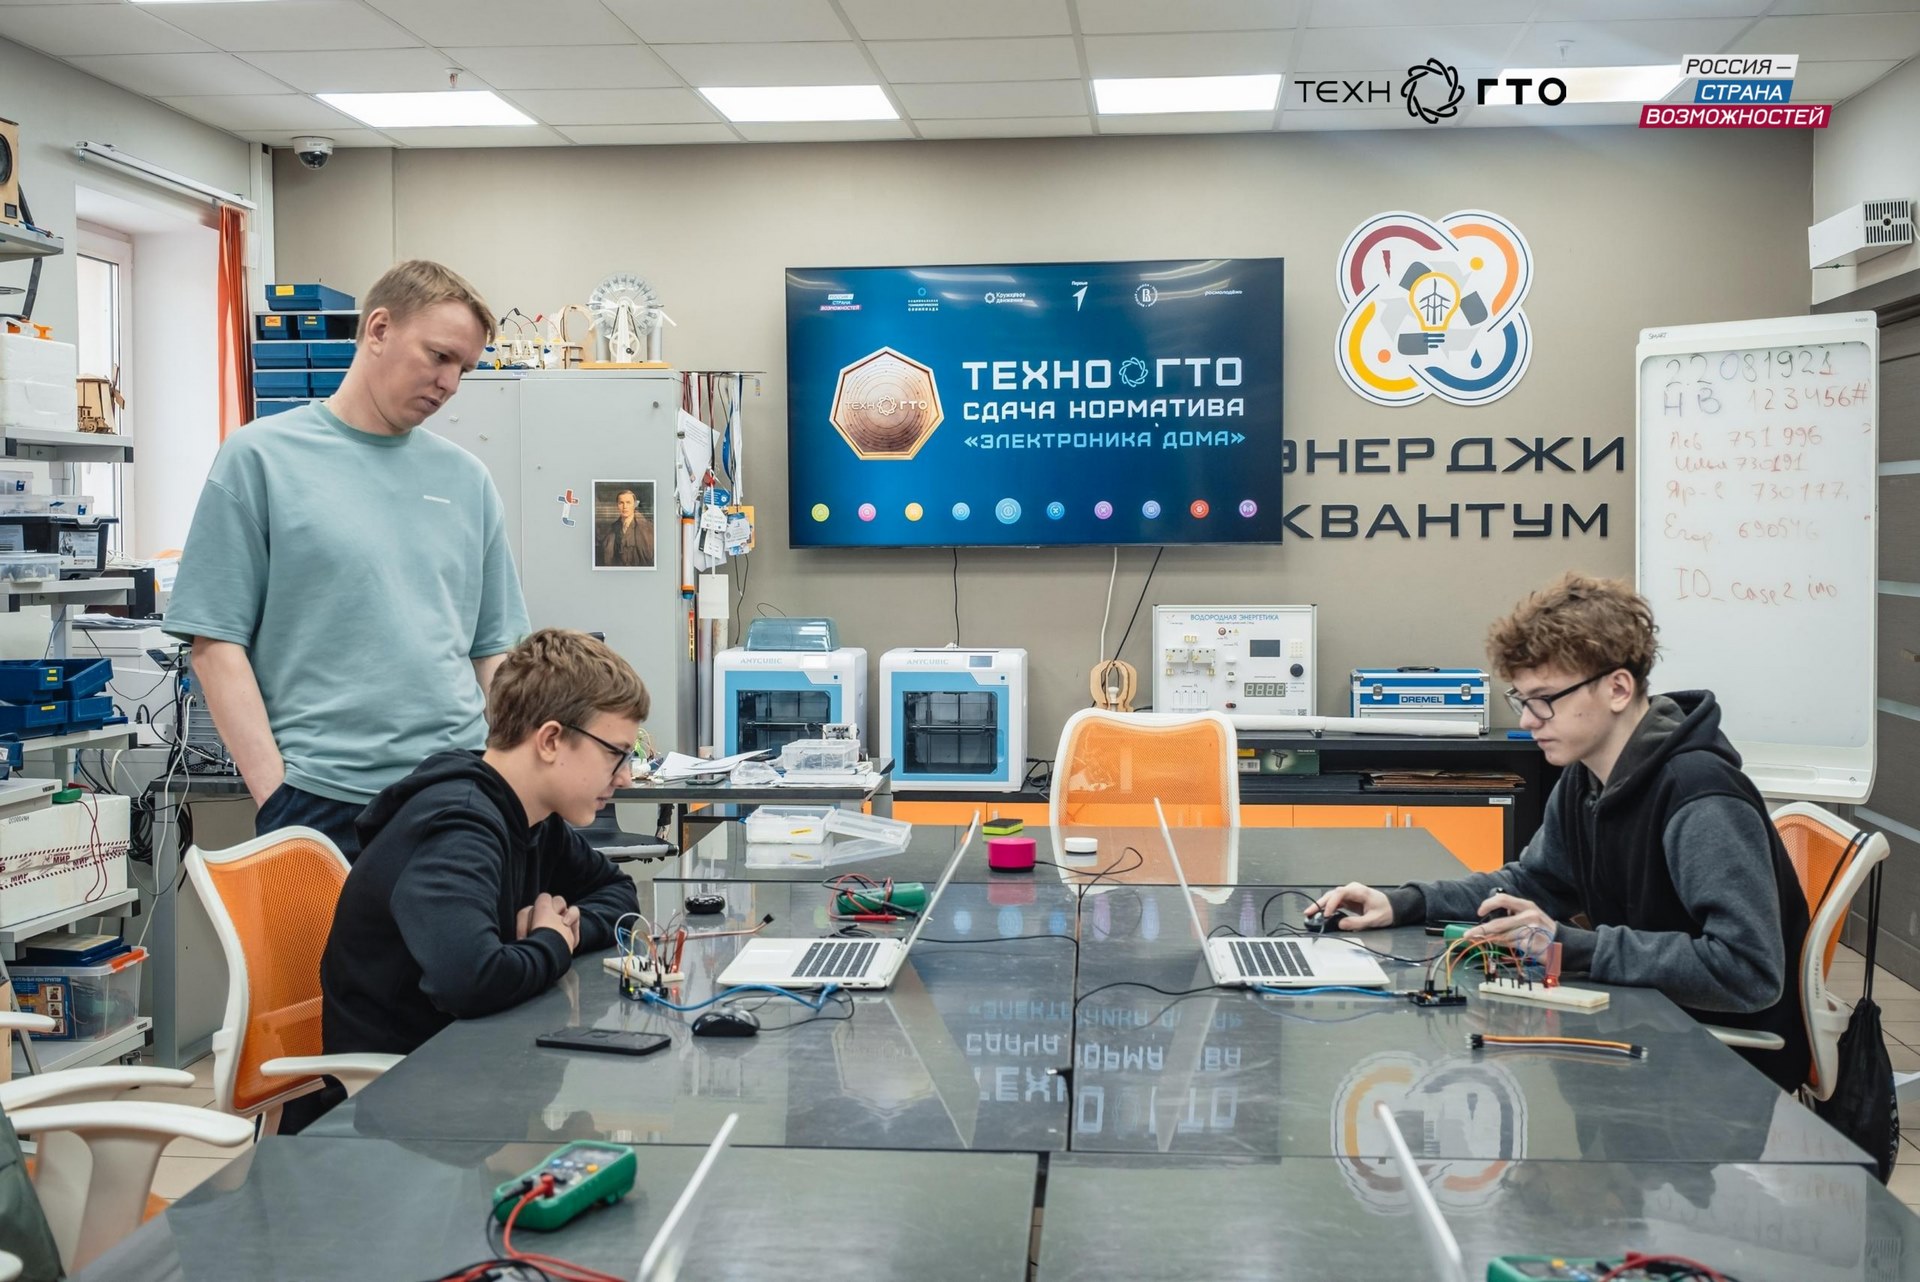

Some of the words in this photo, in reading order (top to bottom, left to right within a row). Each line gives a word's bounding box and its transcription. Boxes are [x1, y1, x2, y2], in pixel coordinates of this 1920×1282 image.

[962, 359, 1112, 390] ТЕХНО
[1156, 357, 1242, 388] ГТО
[900, 401, 928, 410] ГТО
[963, 400, 1056, 423] СДАЧА
[1069, 398, 1244, 419] НОРМАТИВА
[964, 431, 1152, 449] «ЭЛЕКТРОНИКА
[1162, 430, 1247, 449] ДОМА»
[1239, 613, 1280, 621] ЭНЕРГЕТИКА
[1401, 695, 1443, 704] DREMEL
